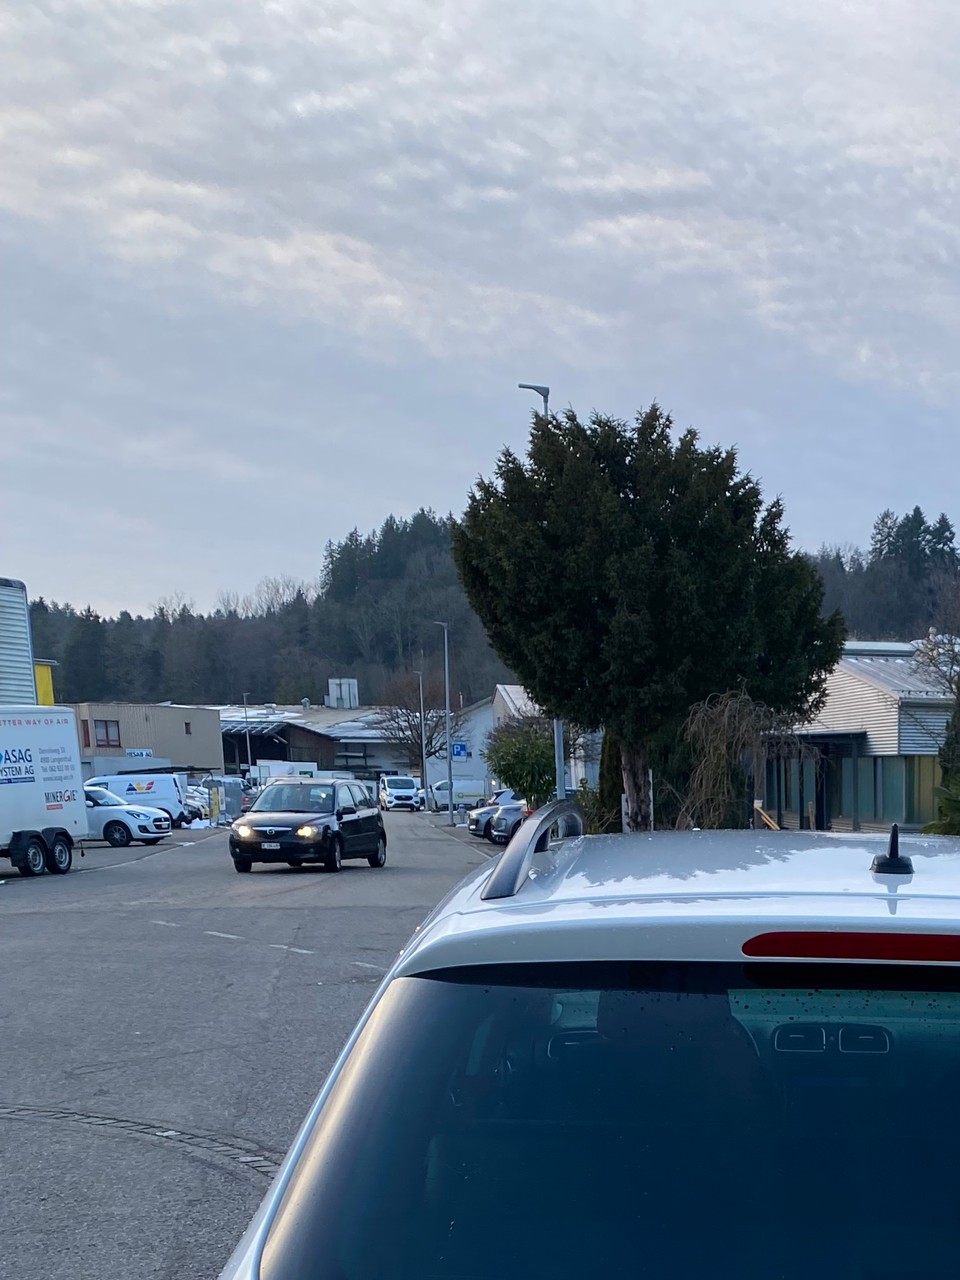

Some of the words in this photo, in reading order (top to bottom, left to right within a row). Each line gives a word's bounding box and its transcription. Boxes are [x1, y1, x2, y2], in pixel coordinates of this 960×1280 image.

[4, 748, 33, 764] ASAG
[0, 766, 22, 777] YSTEM
[24, 765, 35, 776] AG
